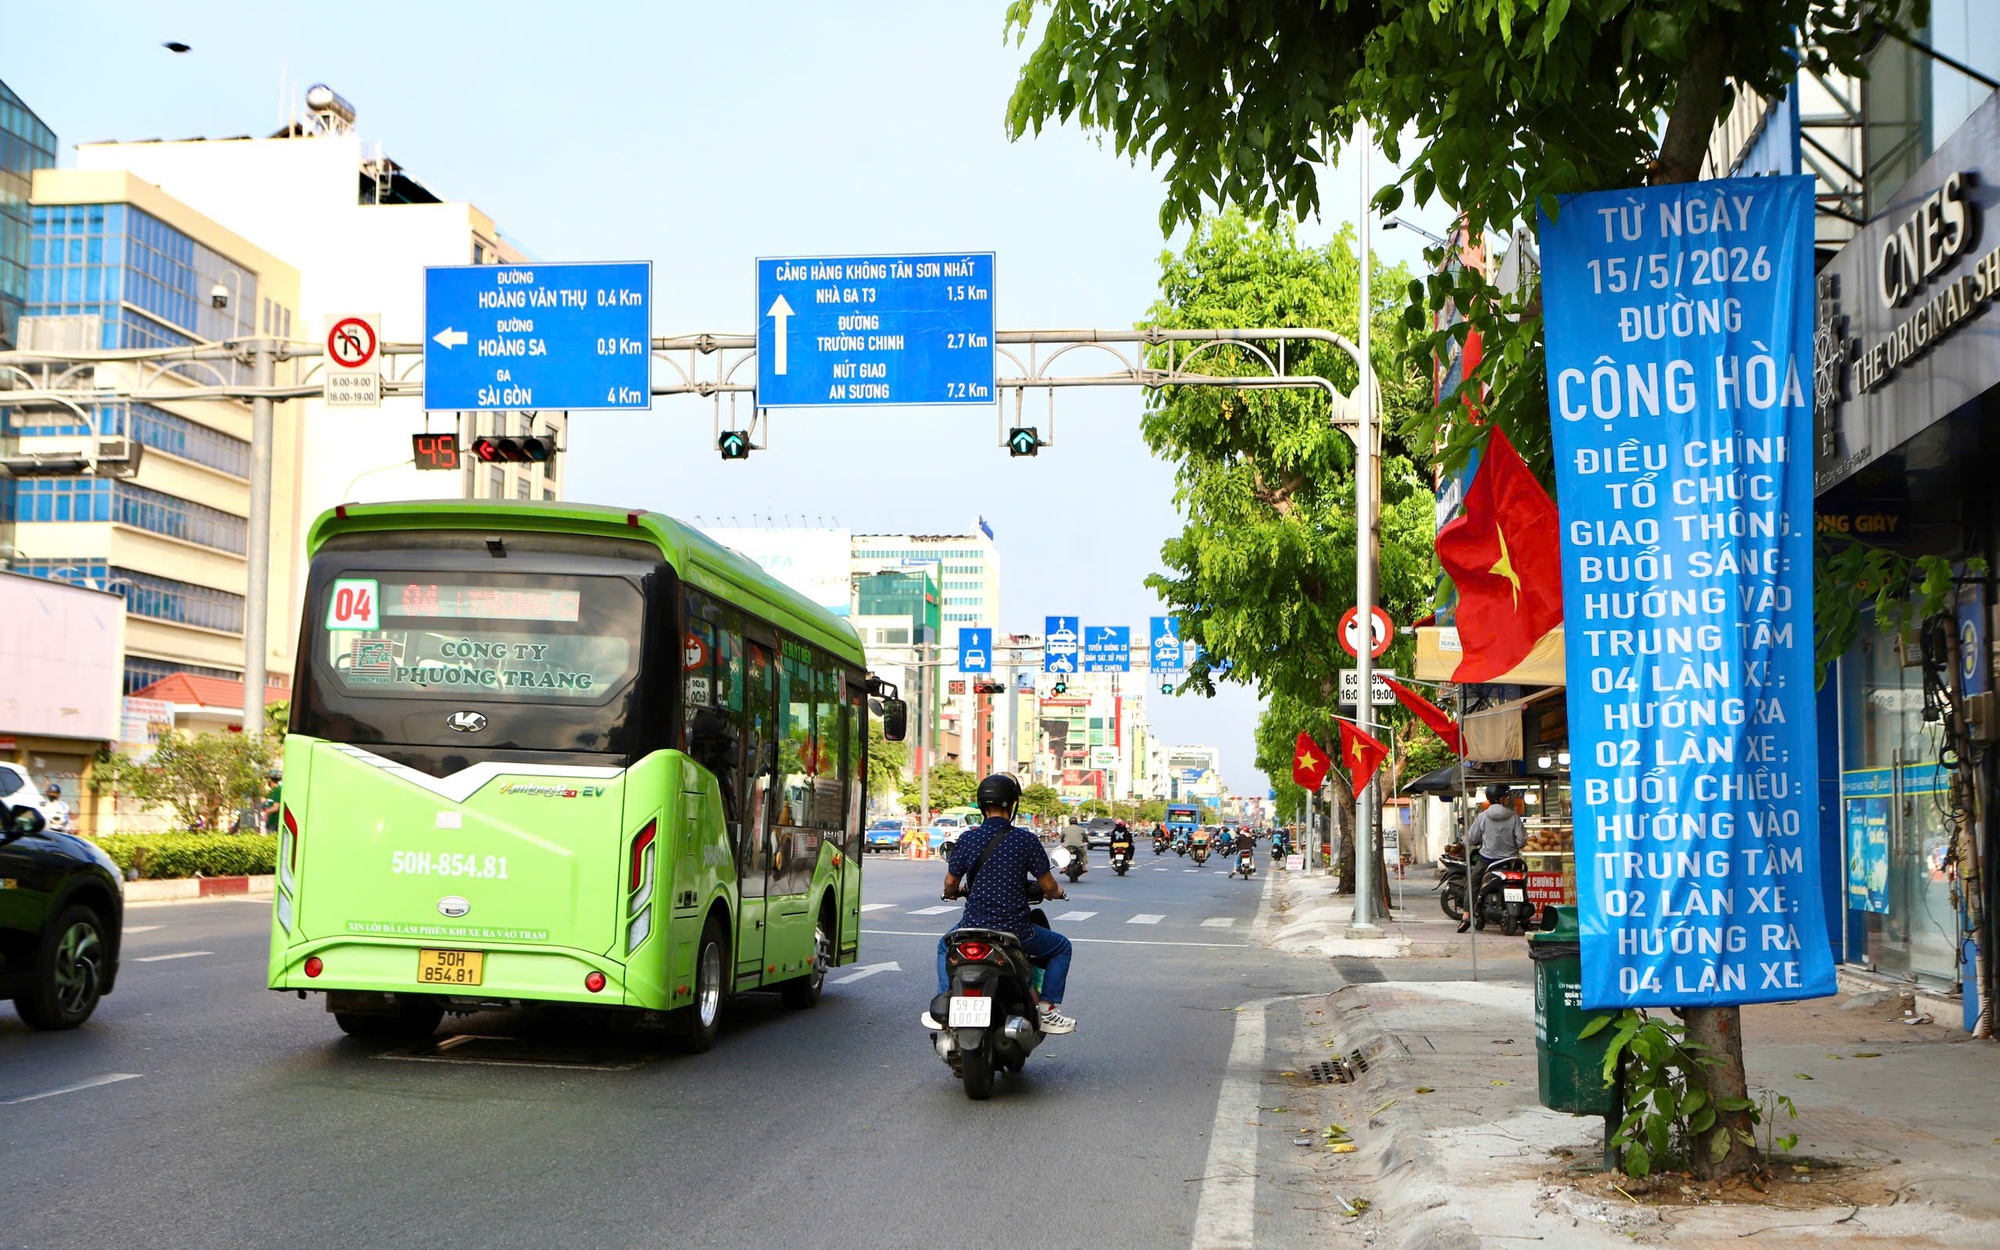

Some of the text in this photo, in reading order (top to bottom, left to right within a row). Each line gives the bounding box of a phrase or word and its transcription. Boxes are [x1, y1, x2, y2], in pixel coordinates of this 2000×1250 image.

[1598, 188, 1754, 243] TỪ NGÀY
[1879, 171, 1970, 309] CNES
[497, 269, 534, 284] ĐƯỜNG
[776, 257, 975, 281] CẢNG HÀNG KHÔNG TÂN SƠN NHẤT
[1587, 246, 1771, 294] 15/5/2026
[479, 286, 642, 310] HOÀNG VĂN THỤ 0,4 Km
[816, 285, 987, 303] NHÀ GA T3 1,5 Km
[497, 317, 533, 332] ĐƯỜNG
[838, 313, 879, 331] ĐƯỜNG
[1618, 293, 1742, 343] ĐƯỜNG
[478, 335, 642, 356] HOÀNG SA 0,9 Km
[817, 333, 987, 352] TRƯỜNG CHINH 2,7 Km
[1853, 342, 1885, 395] THE
[1887, 275, 1972, 370] ORIGINAL
[497, 369, 511, 381] GA
[833, 359, 886, 379] NÚT GIAO
[478, 384, 641, 406] SÀI GÒN 4 Km
[829, 383, 988, 400] AN SƯƠNG 7,2 Km
[1557, 340, 1806, 432] CỘNG HÒA
[418, 436, 456, 468] 45
[1573, 438, 1668, 475] ĐIỀU
[1683, 430, 1791, 468] CHỈNH
[1605, 468, 1774, 510] TỔ CHỨC
[1570, 518, 1660, 546] GIAO
[1580, 546, 1673, 583] BUỔI
[335, 588, 371, 621] 04
[403, 584, 439, 616] 04
[1585, 579, 1792, 620] HƯỚNG VÀO
[440, 637, 548, 661] CÔNG TY
[1583, 619, 1793, 657] TRUNG TÂM
[395, 664, 594, 691] PHƯƠNG TRANG
[1104, 664, 1123, 672] CAMERA
[1591, 667, 1639, 694] 04
[1652, 657, 1730, 692] LÀN
[1603, 695, 1786, 730] HƯỚNG RA
[1595, 740, 1642, 768] 02
[1655, 731, 1733, 766] LÀN
[1585, 767, 1677, 805] BUỔI
[1597, 803, 1800, 843] HƯỚNG VÀO
[392, 850, 509, 879] 50H-854.81
[1596, 843, 1803, 880] TRUNG TÂM
[1605, 889, 1646, 918] 02
[1662, 881, 1735, 917] LÀN
[349, 922, 364, 932] XIN
[449, 927, 467, 936] KHI
[468, 928, 480, 936] XE
[482, 929, 496, 937] RA
[519, 931, 547, 941] TRẠM
[1618, 921, 1802, 956] HƯỚNG RA
[425, 967, 474, 983] 854.81
[437, 952, 465, 967] 50H
[1619, 958, 1803, 994] 04 LÀN XE
